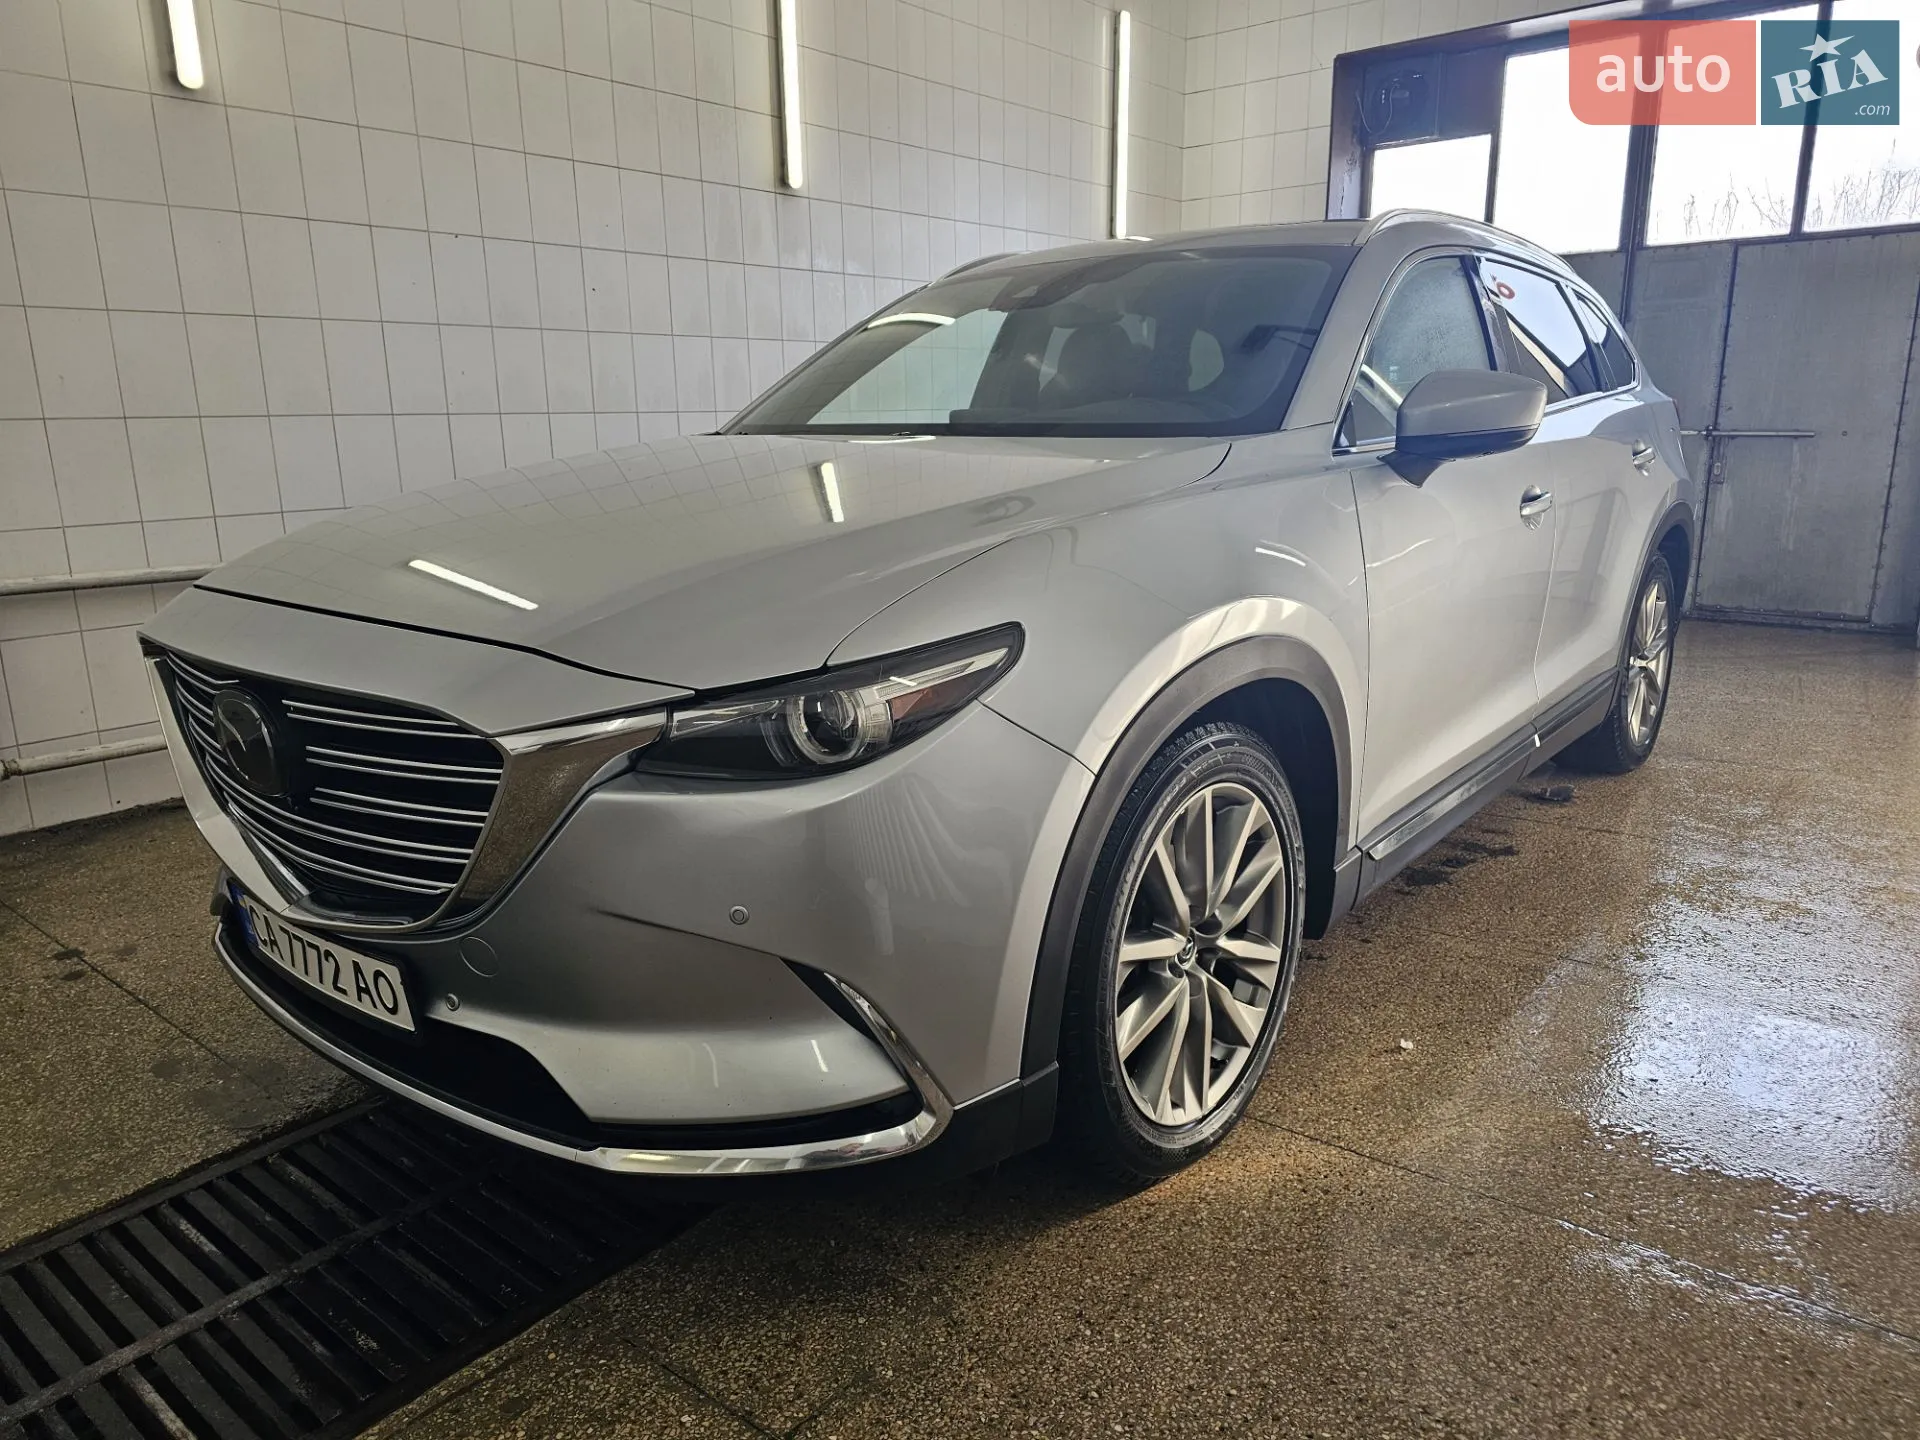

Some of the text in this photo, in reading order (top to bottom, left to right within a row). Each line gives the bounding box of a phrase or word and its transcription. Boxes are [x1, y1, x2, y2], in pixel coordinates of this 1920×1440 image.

[249, 904, 399, 1016] CA 7772 AO
